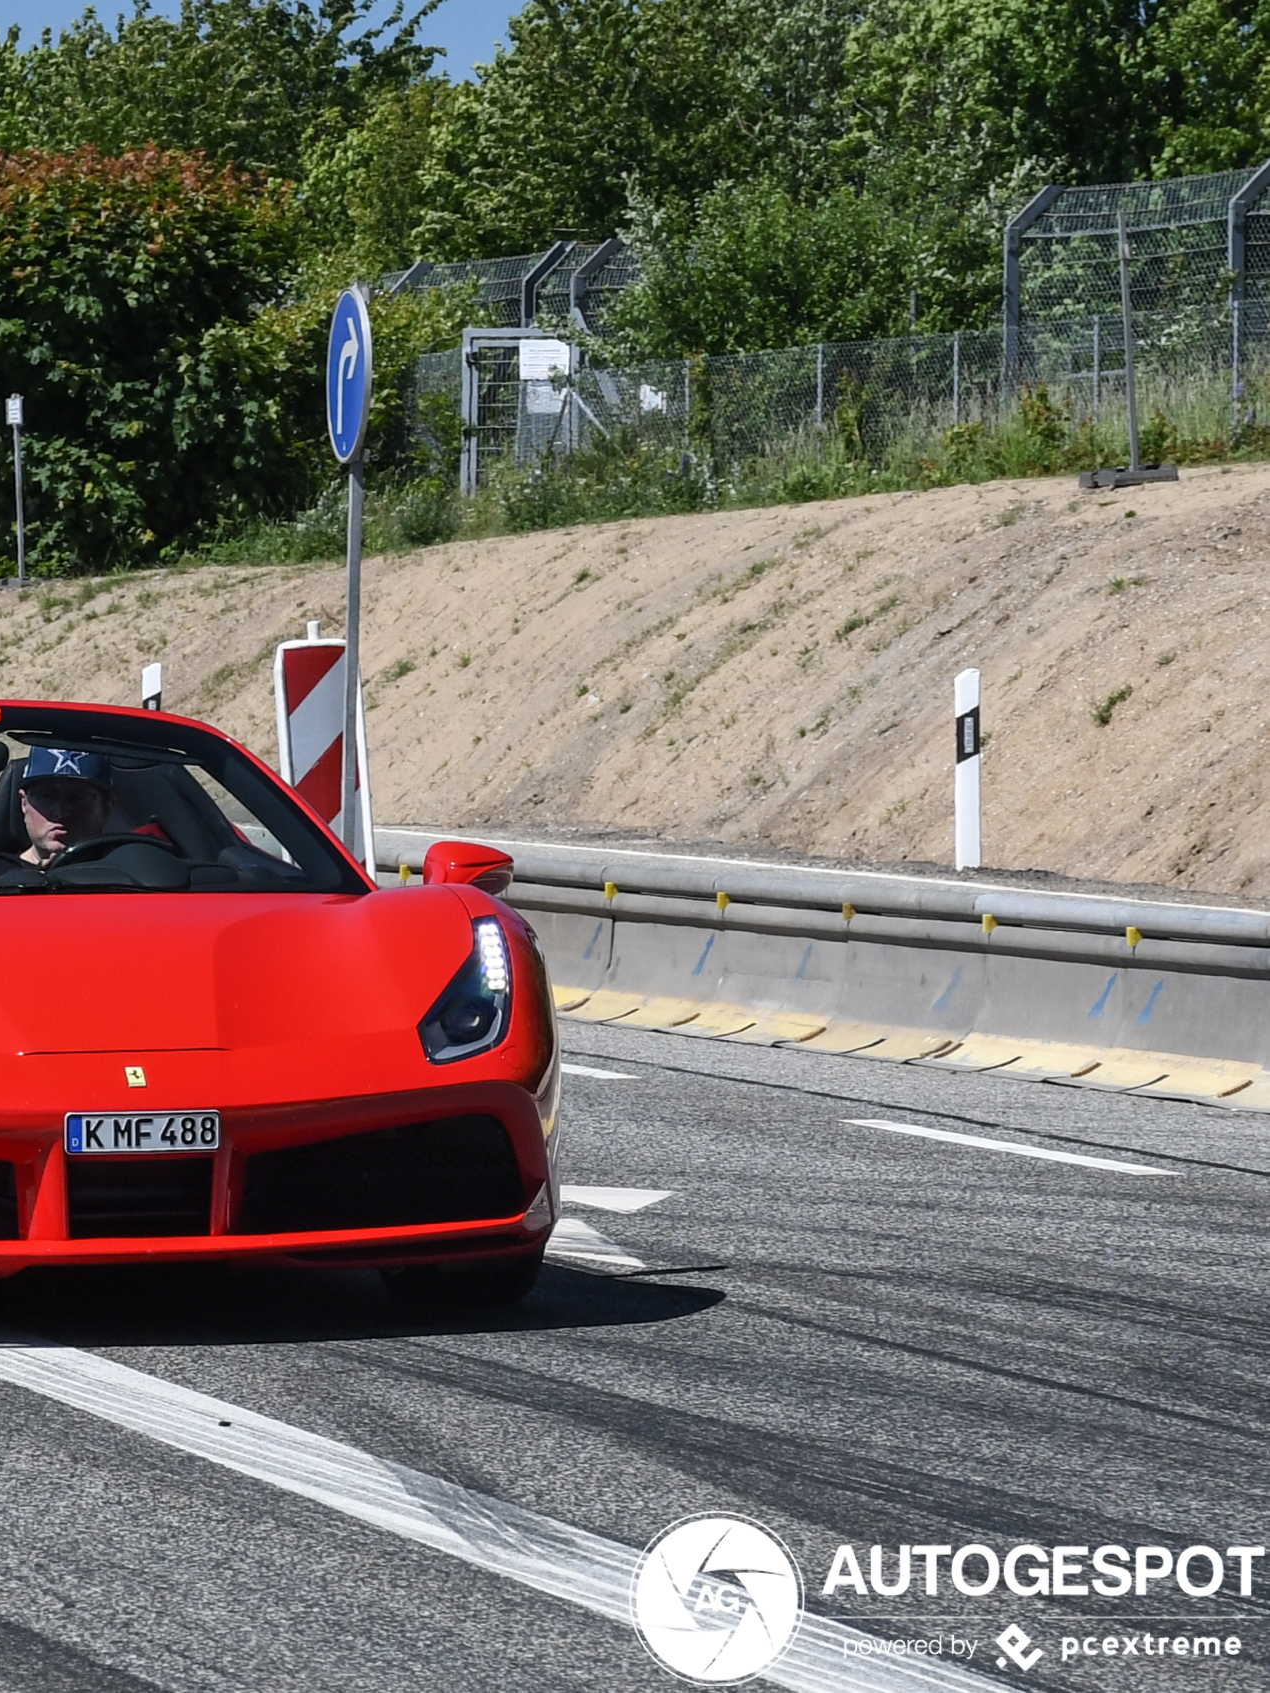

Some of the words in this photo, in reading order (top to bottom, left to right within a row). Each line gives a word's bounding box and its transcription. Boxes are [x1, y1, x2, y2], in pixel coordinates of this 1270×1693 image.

[71, 1137, 80, 1147] D
[85, 1119, 104, 1148] K
[113, 1118, 154, 1147] MF
[160, 1116, 216, 1146] 488
